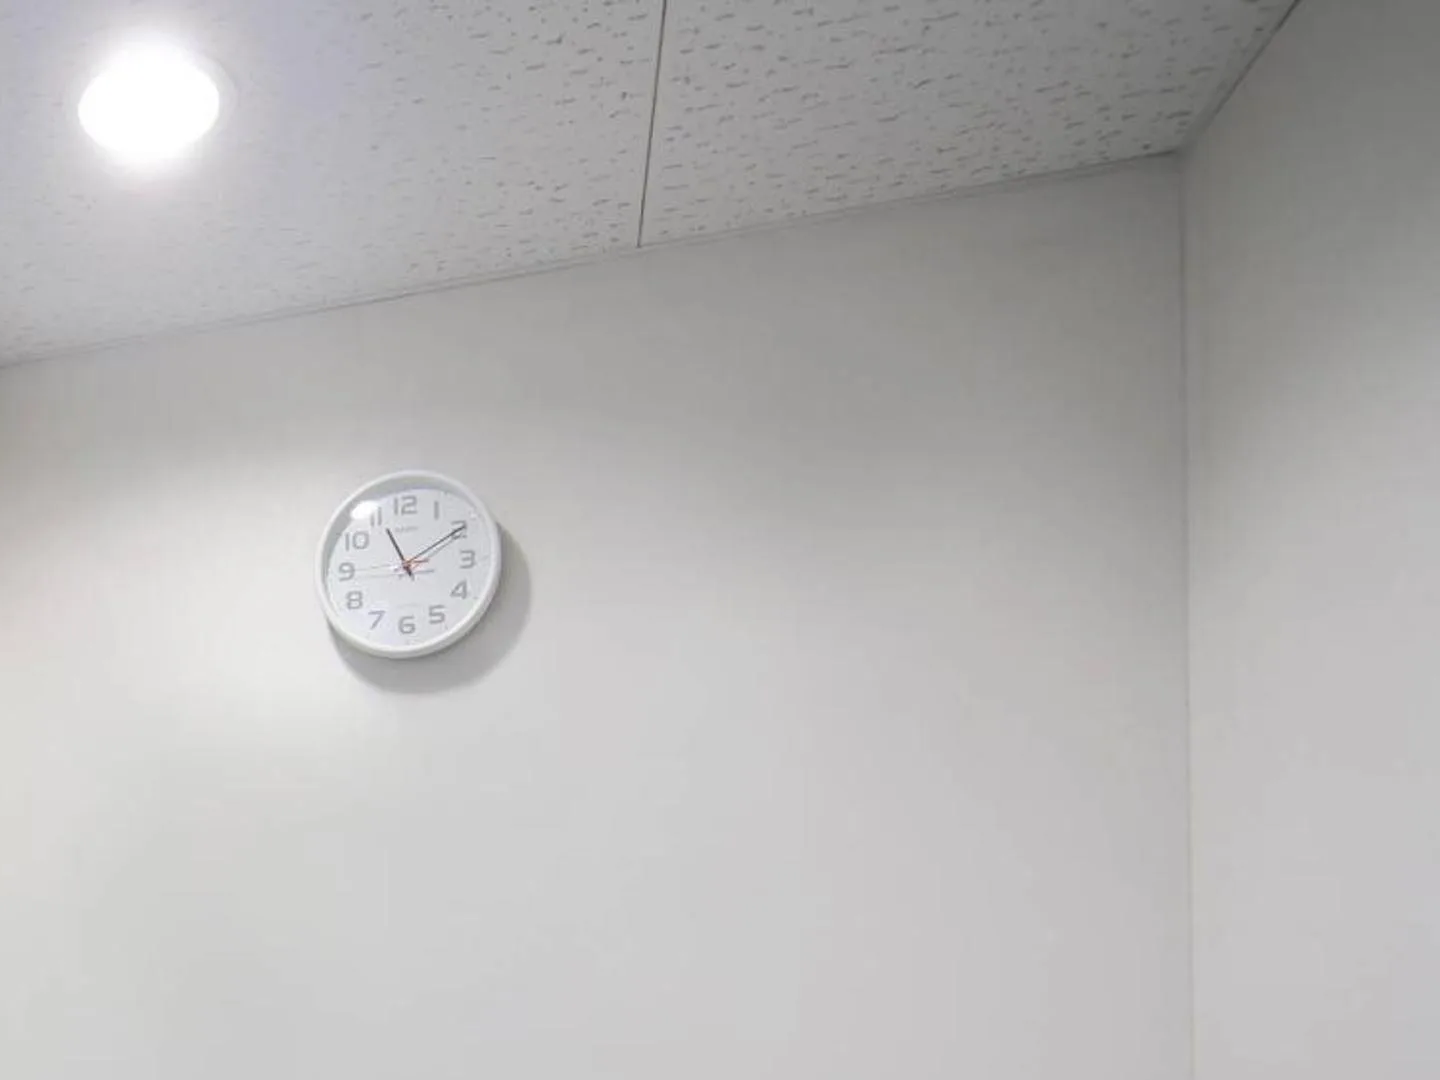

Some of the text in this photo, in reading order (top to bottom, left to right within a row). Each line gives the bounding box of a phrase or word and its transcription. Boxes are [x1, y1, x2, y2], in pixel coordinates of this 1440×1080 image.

[394, 495, 418, 516] 12
[433, 501, 439, 520] 1
[370, 506, 382, 527] 11
[451, 520, 467, 541] 2
[344, 531, 370, 551] 10
[460, 550, 476, 569] 3
[338, 562, 355, 581] 9
[450, 580, 468, 599] 4
[346, 591, 363, 610] 8
[367, 610, 386, 630] 7
[428, 605, 446, 624] 5
[398, 616, 415, 635] 6
